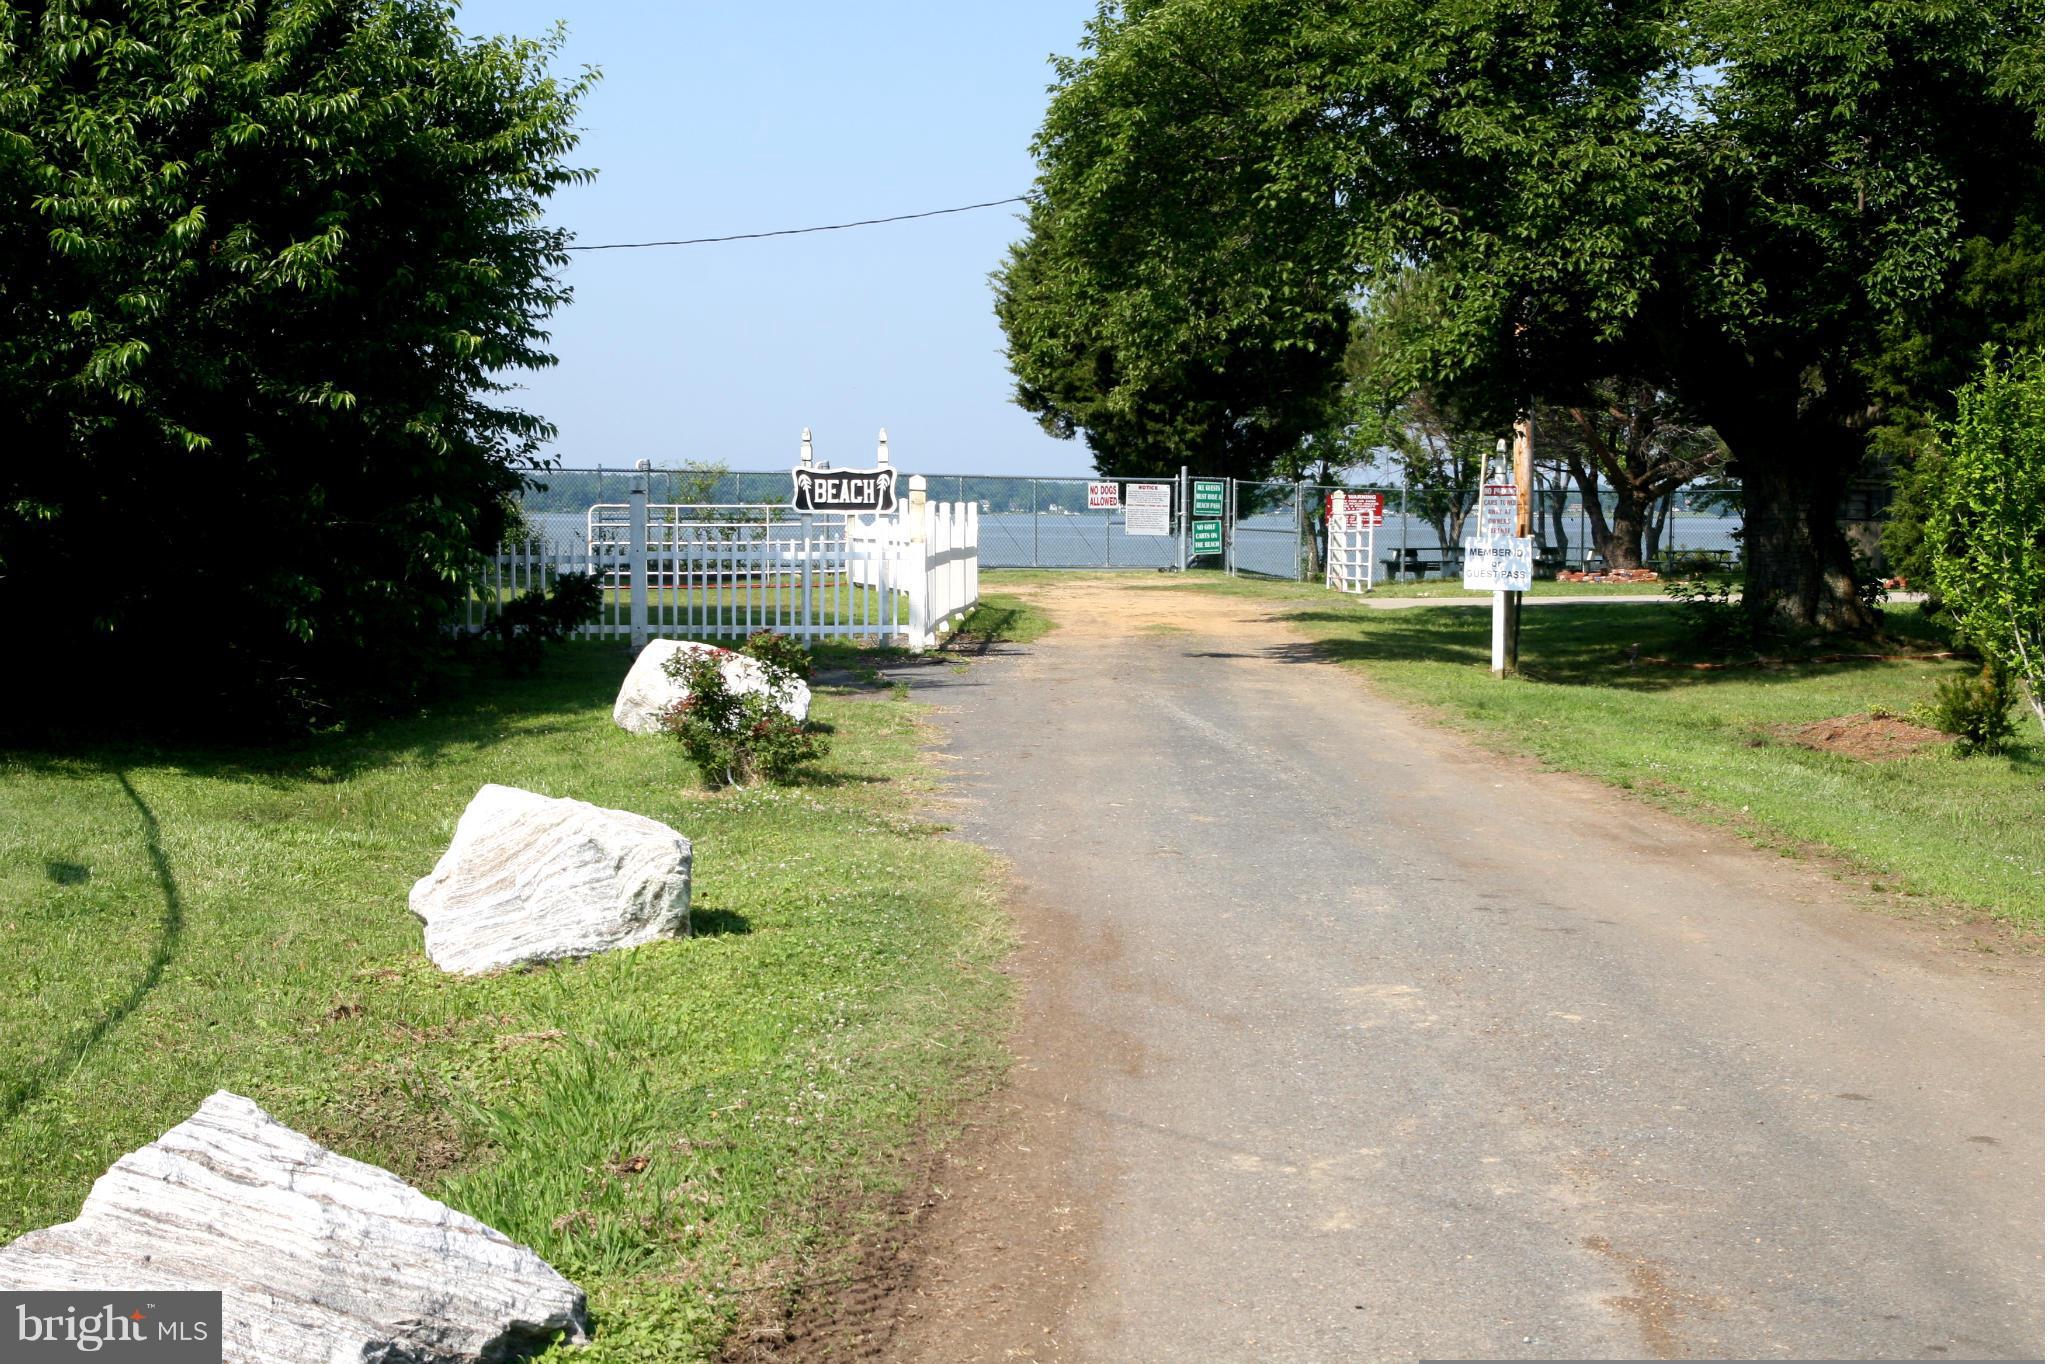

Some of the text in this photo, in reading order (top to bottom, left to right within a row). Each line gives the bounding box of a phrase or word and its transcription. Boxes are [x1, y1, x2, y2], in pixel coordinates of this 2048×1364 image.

[814, 479, 876, 504] BEACH
[1090, 485, 1117, 495] NO DOGS
[1090, 497, 1117, 506] ALLOWED
[1469, 548, 1524, 558] MEMBER ID
[1466, 569, 1526, 579] GUEST PASS
